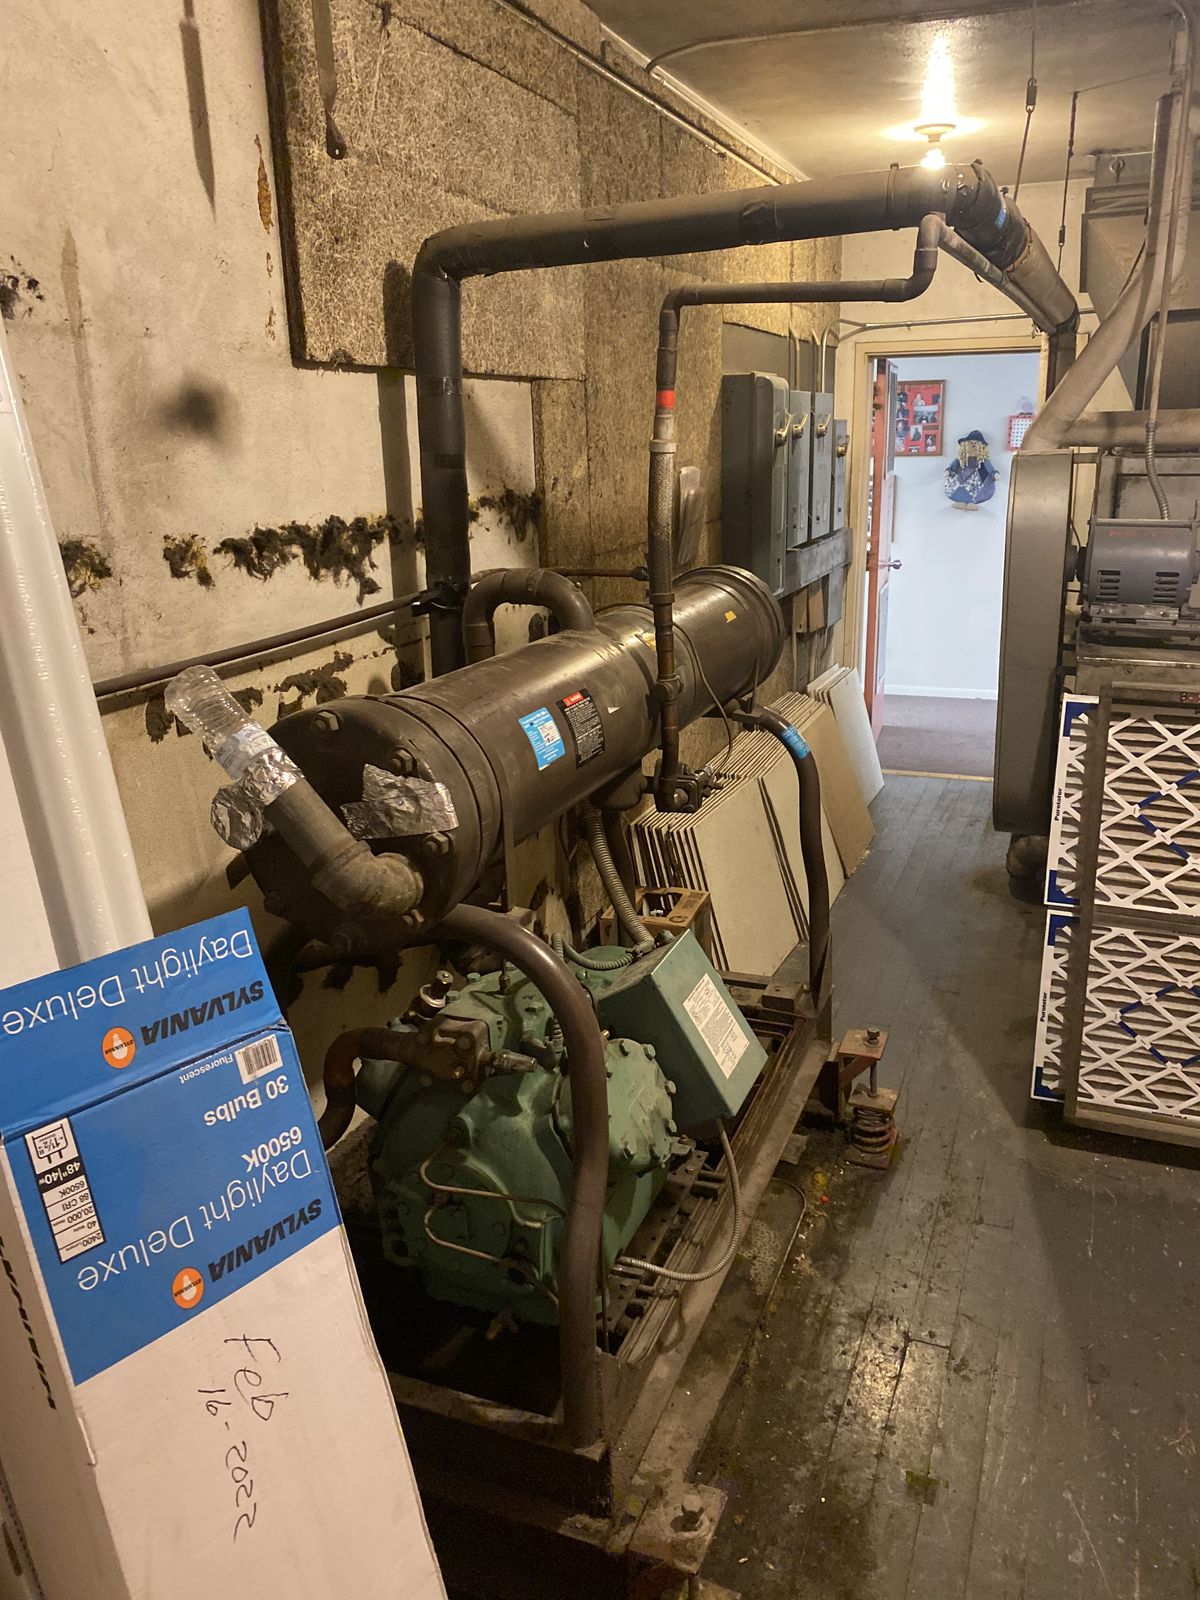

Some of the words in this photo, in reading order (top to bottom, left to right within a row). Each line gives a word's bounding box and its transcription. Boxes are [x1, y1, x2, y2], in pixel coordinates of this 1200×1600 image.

[1053, 787, 1062, 821] Purolator
[134, 929, 254, 993] Daylight
[2, 975, 126, 1035] Deluxe
[141, 980, 265, 1046] SYLVANIA
[1039, 991, 1048, 1023] Purolator
[179, 1054, 234, 1084] Fluorescent
[266, 1075, 289, 1099] 30
[203, 1088, 263, 1127] Bulbs
[242, 1126, 302, 1171] 6500K
[58, 1180, 85, 1197] 6500K
[61, 1198, 78, 1211] CRI
[199, 1150, 312, 1231] Daylight
[67, 1206, 94, 1223] 20,000
[87, 1220, 97, 1229] 40
[77, 1214, 195, 1291] Deluxe
[82, 1232, 102, 1247] 2400
[209, 1198, 322, 1283] SYLVANIA
[224, 1334, 289, 1421] Feb
[225, 1441, 257, 1544] 2022
